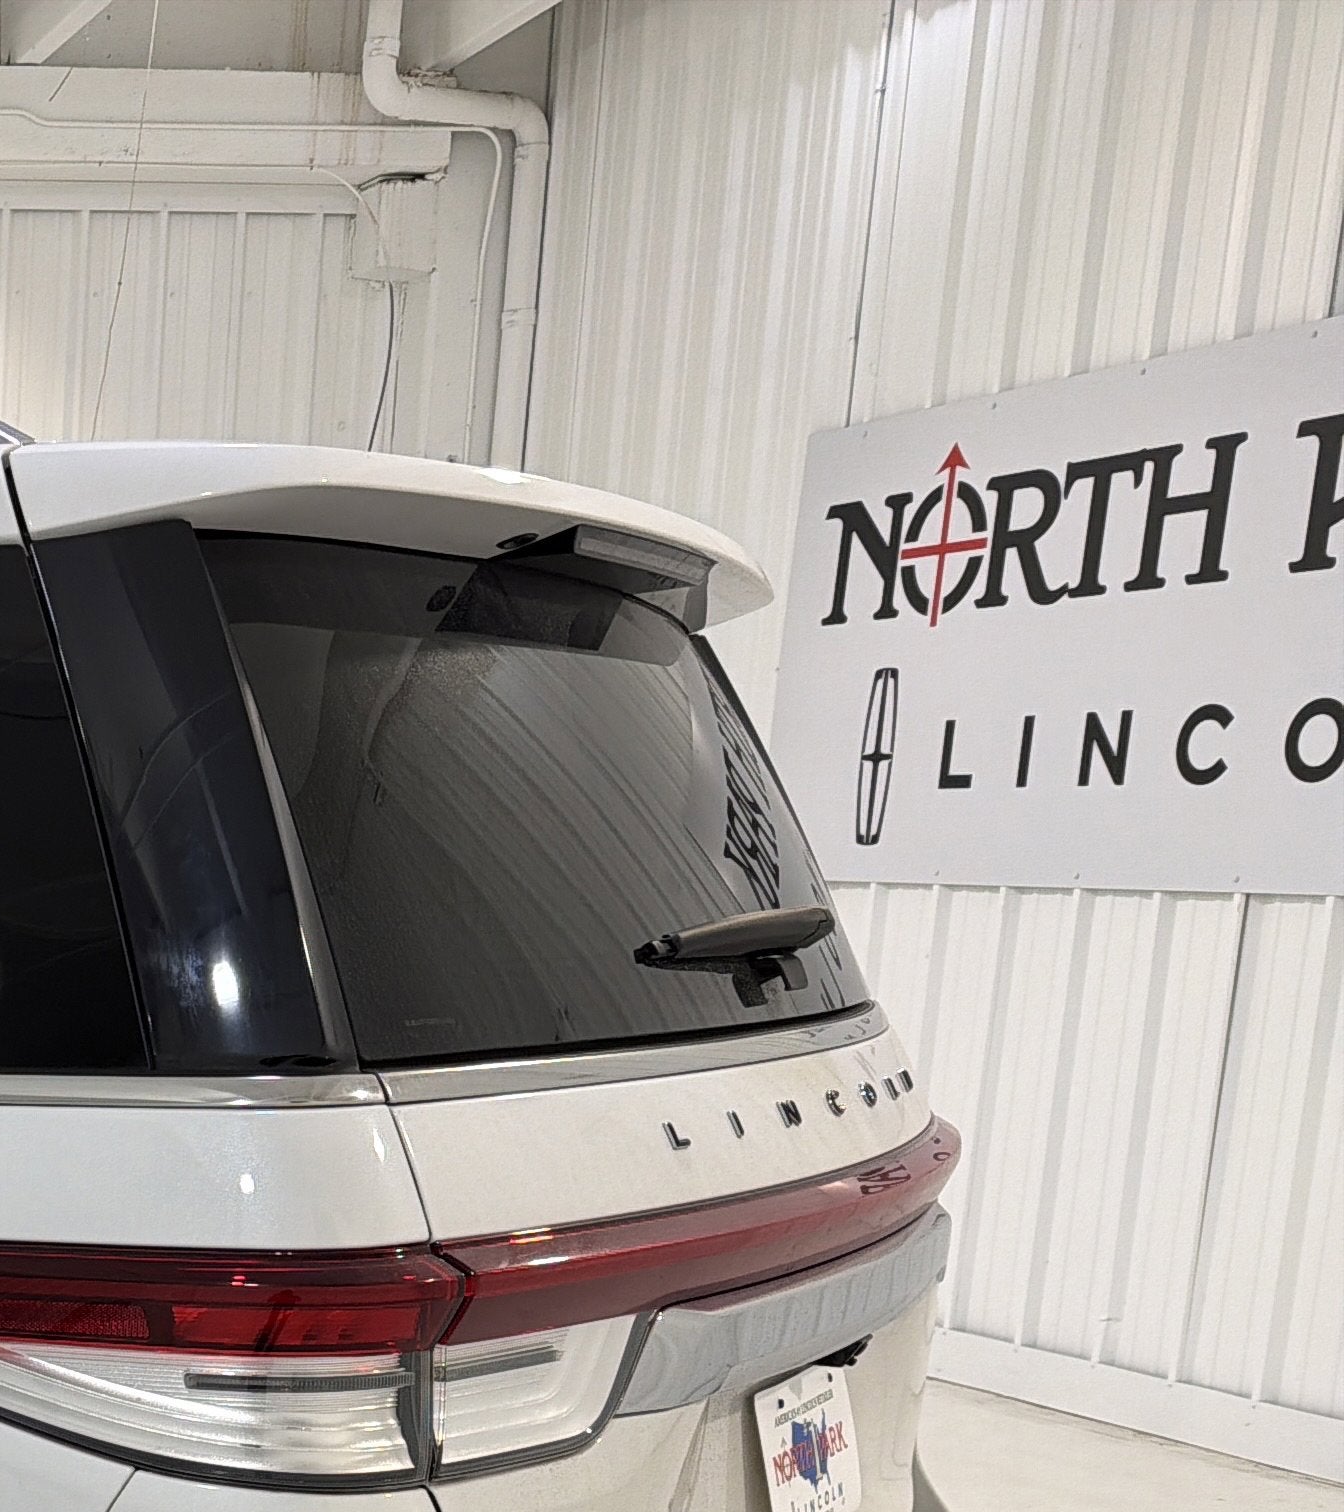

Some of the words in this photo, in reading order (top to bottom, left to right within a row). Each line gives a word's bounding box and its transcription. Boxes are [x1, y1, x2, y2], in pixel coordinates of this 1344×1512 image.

[821, 431, 1249, 627] NORTH
[938, 697, 1344, 790] LINCO
[662, 1065, 913, 1150] LINCOLN
